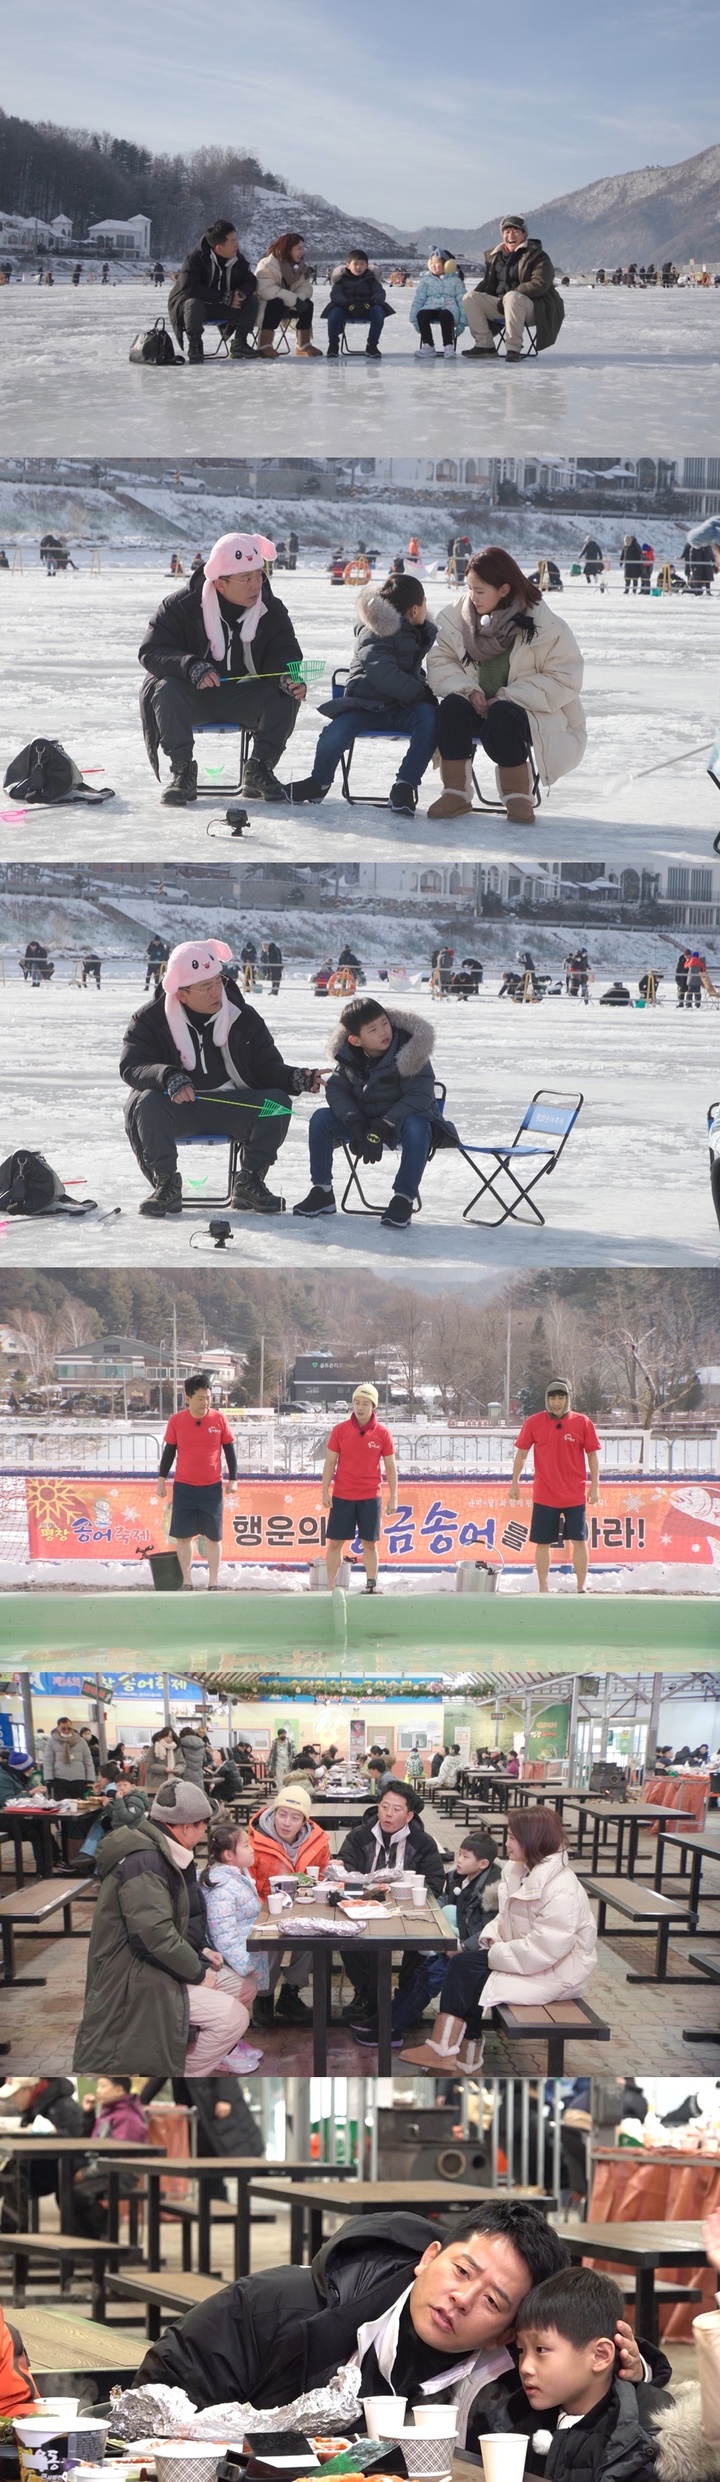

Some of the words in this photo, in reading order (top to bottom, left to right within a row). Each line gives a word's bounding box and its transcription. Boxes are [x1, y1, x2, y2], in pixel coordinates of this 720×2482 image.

[40, 1527, 70, 1542] 평창
[72, 1517, 112, 1543] 송어
[115, 1526, 150, 1545] 축제
[232, 1515, 327, 1547] 행운의
